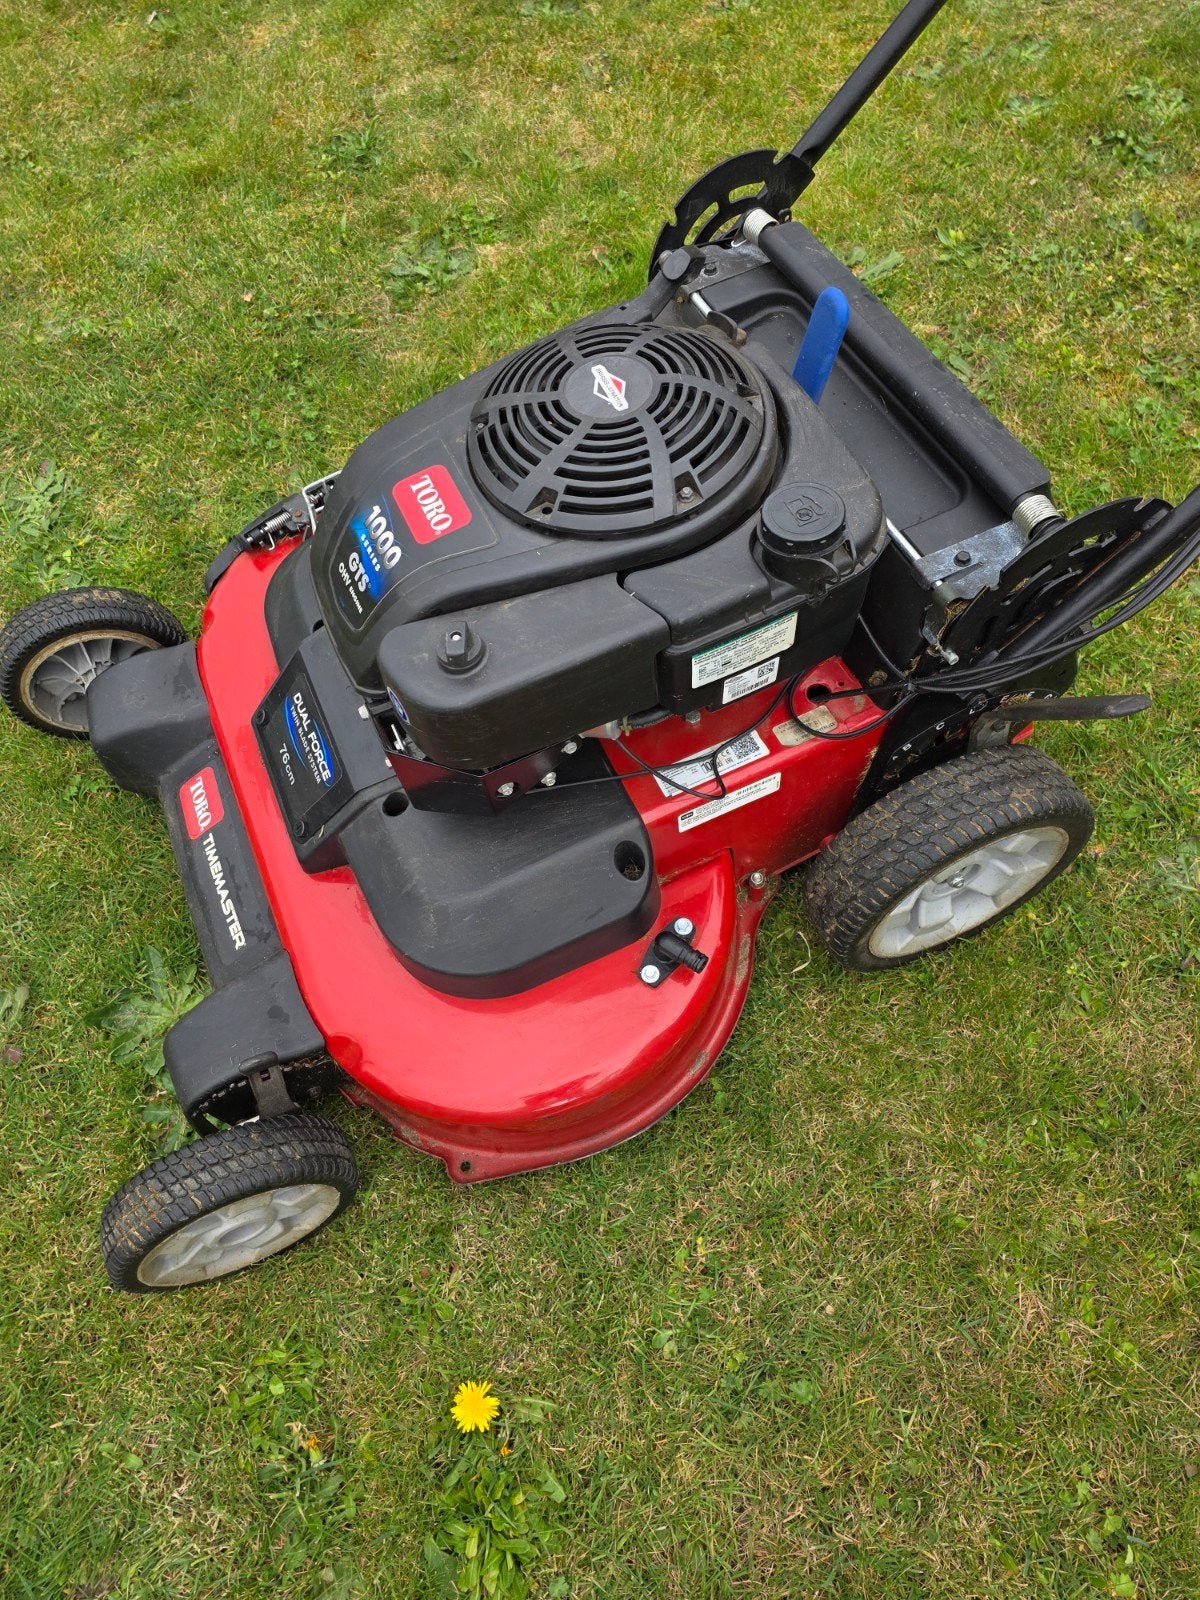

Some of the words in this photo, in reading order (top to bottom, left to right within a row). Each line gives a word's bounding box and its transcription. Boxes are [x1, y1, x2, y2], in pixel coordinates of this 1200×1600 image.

[409, 474, 453, 532] TORO
[360, 533, 381, 572] SERIES
[364, 505, 402, 570] 1000
[338, 562, 352, 587] OHV
[348, 586, 363, 614] ENGINE
[348, 552, 370, 593] GTS
[279, 742, 295, 786] 76cm
[290, 705, 301, 726] TWIN
[297, 726, 310, 753] BLADE
[307, 753, 322, 785] SYSTEM
[293, 692, 312, 732] DUAL
[307, 731, 332, 782] FORCE
[189, 776, 212, 829] TORO
[202, 832, 246, 950] TIMEMASTER
